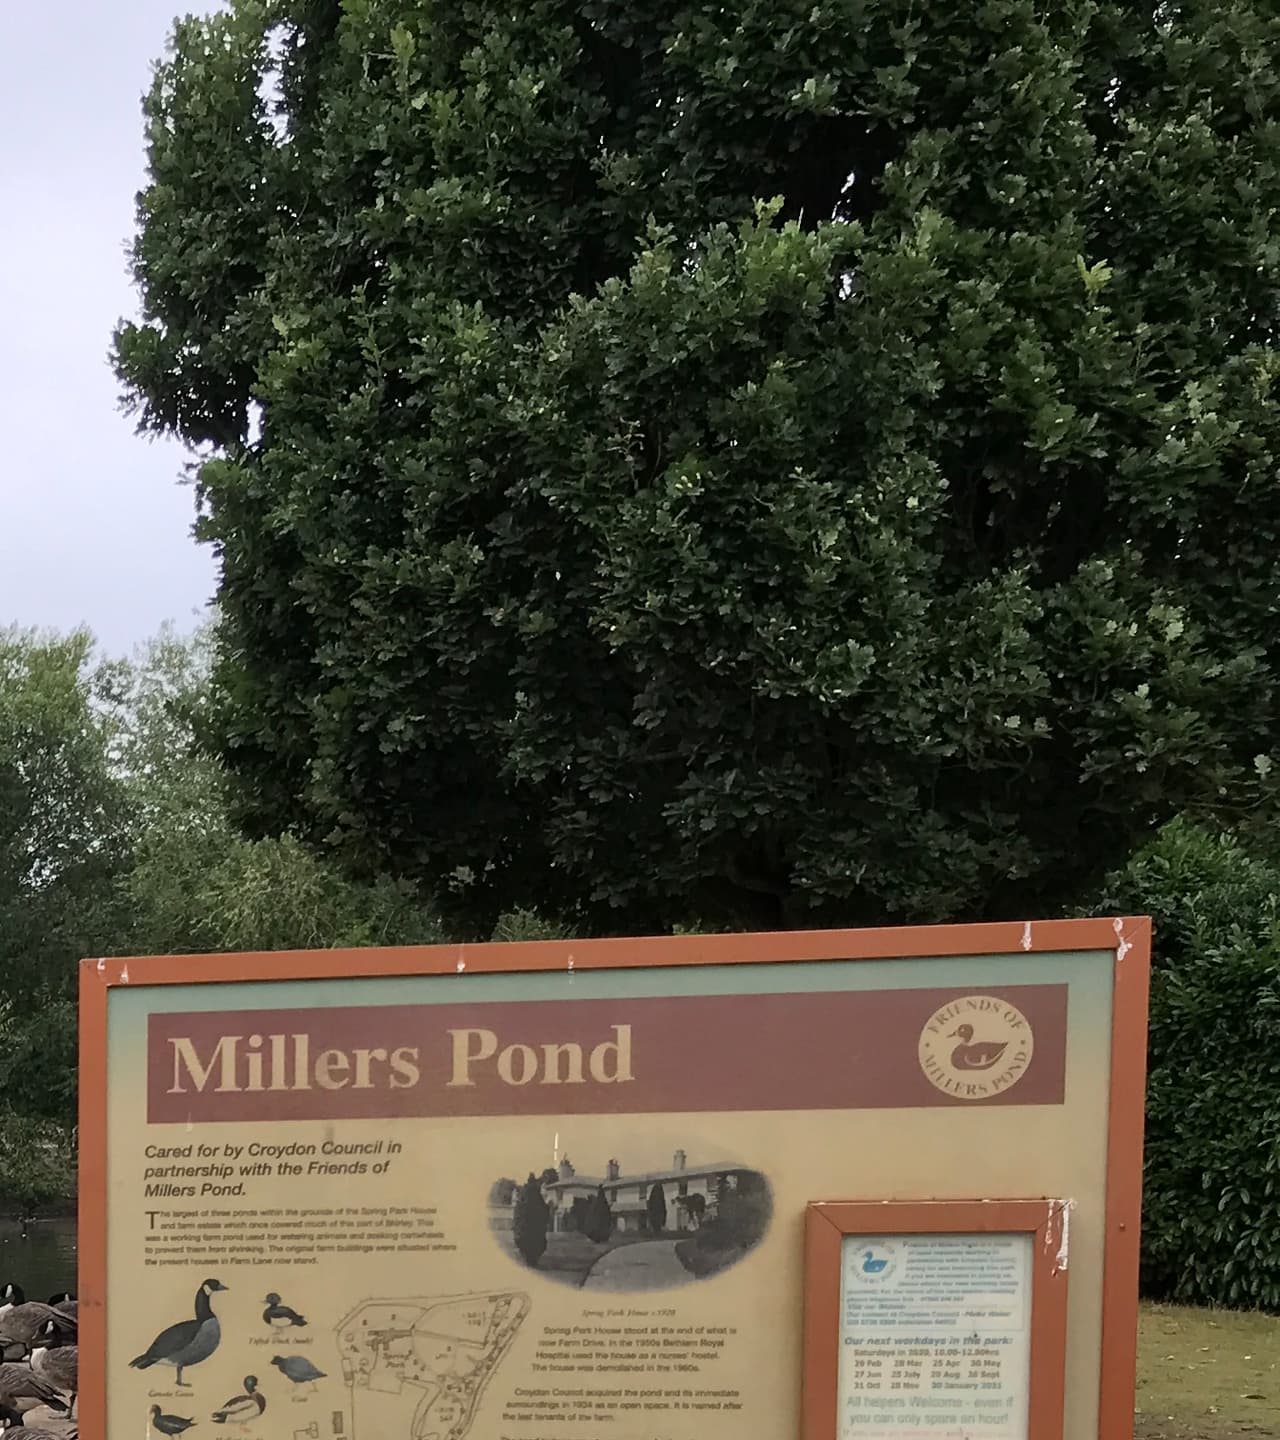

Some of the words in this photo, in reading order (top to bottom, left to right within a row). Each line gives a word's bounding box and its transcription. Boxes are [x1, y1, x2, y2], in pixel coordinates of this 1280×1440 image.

[927, 999, 1001, 1034] FRIENDS
[1003, 1011, 1024, 1029] OF
[166, 1034, 420, 1093] Millers
[445, 1024, 635, 1086] Pond
[925, 1054, 988, 1095] MILLERS
[992, 1051, 1027, 1091] POND
[144, 1144, 192, 1159] Cared
[197, 1143, 219, 1158] for
[224, 1143, 244, 1160] by
[248, 1141, 316, 1159] Croydon
[321, 1141, 382, 1156] Council
[387, 1141, 402, 1154] in
[144, 1164, 234, 1180] partnership
[239, 1163, 272, 1177] with
[277, 1162, 303, 1176] the
[307, 1160, 367, 1175] Friends
[372, 1160, 390, 1174] of
[144, 1184, 196, 1198] Millers
[201, 1183, 247, 1197] Pond.
[895, 1337, 946, 1346] workdays
[984, 1337, 1013, 1346] park:
